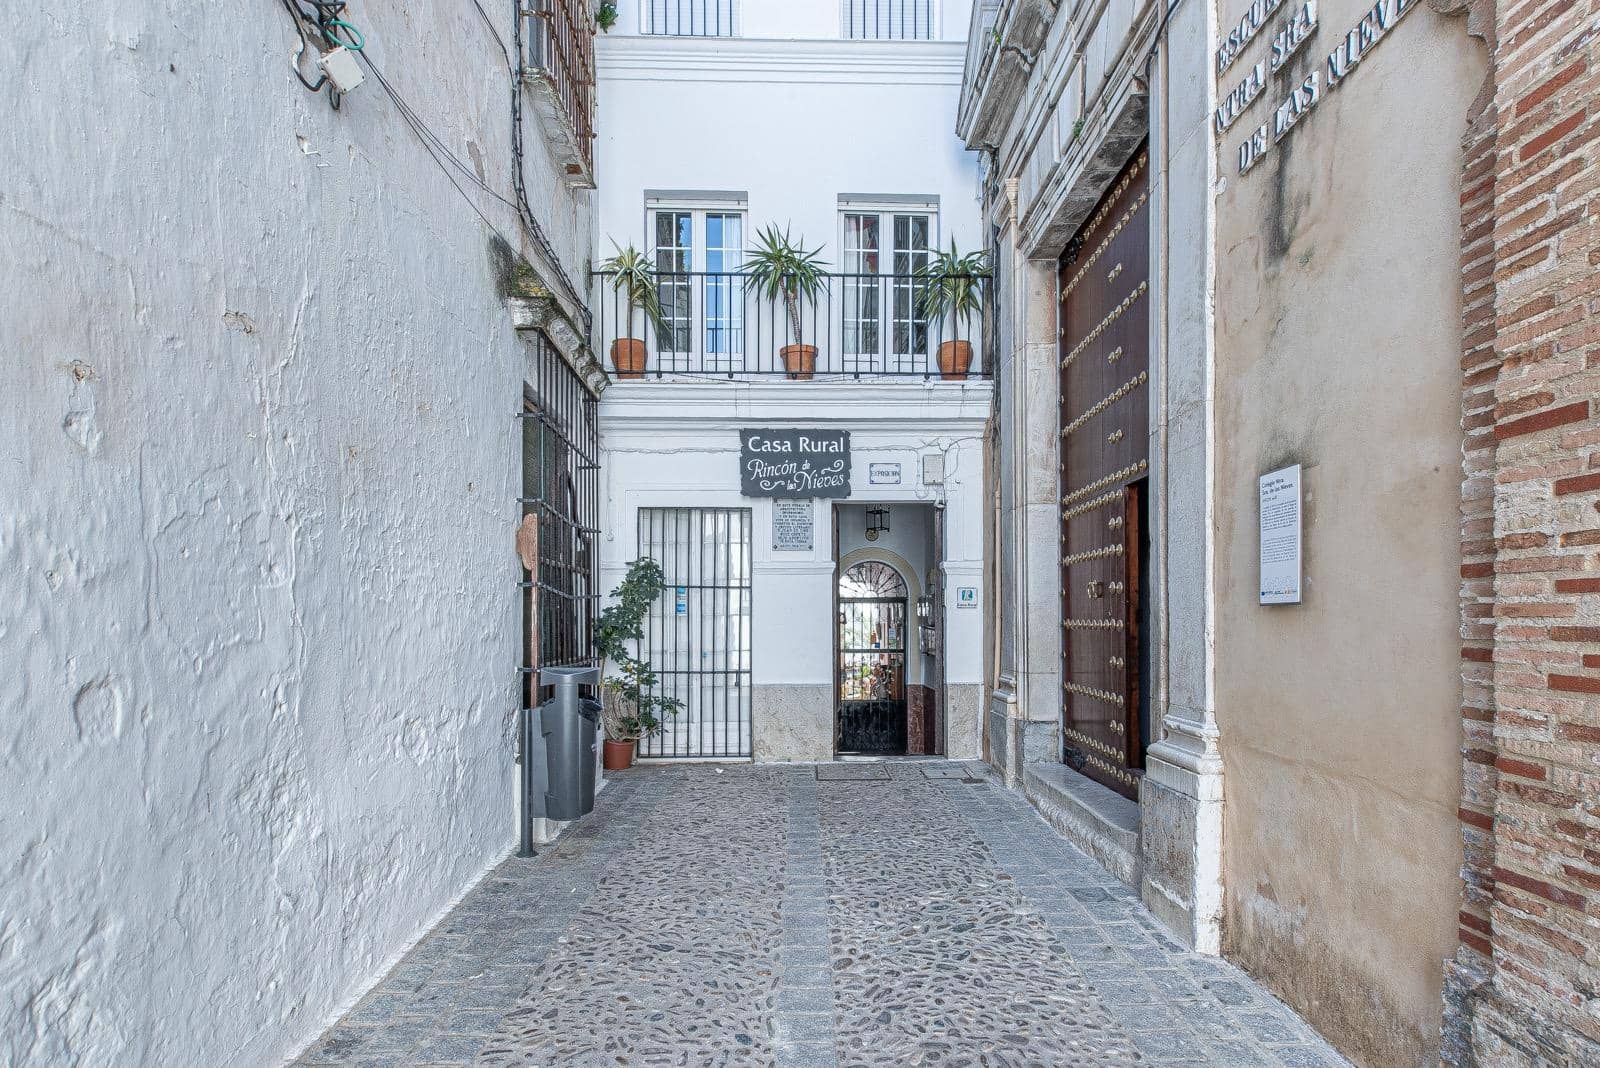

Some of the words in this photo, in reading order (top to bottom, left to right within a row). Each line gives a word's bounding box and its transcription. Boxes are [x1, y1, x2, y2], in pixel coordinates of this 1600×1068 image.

[1238, 123, 1268, 174] DE
[748, 436, 792, 453] Casa
[799, 436, 844, 453] Rural
[747, 458, 797, 481] Rincón
[794, 469, 844, 492] Nieves
